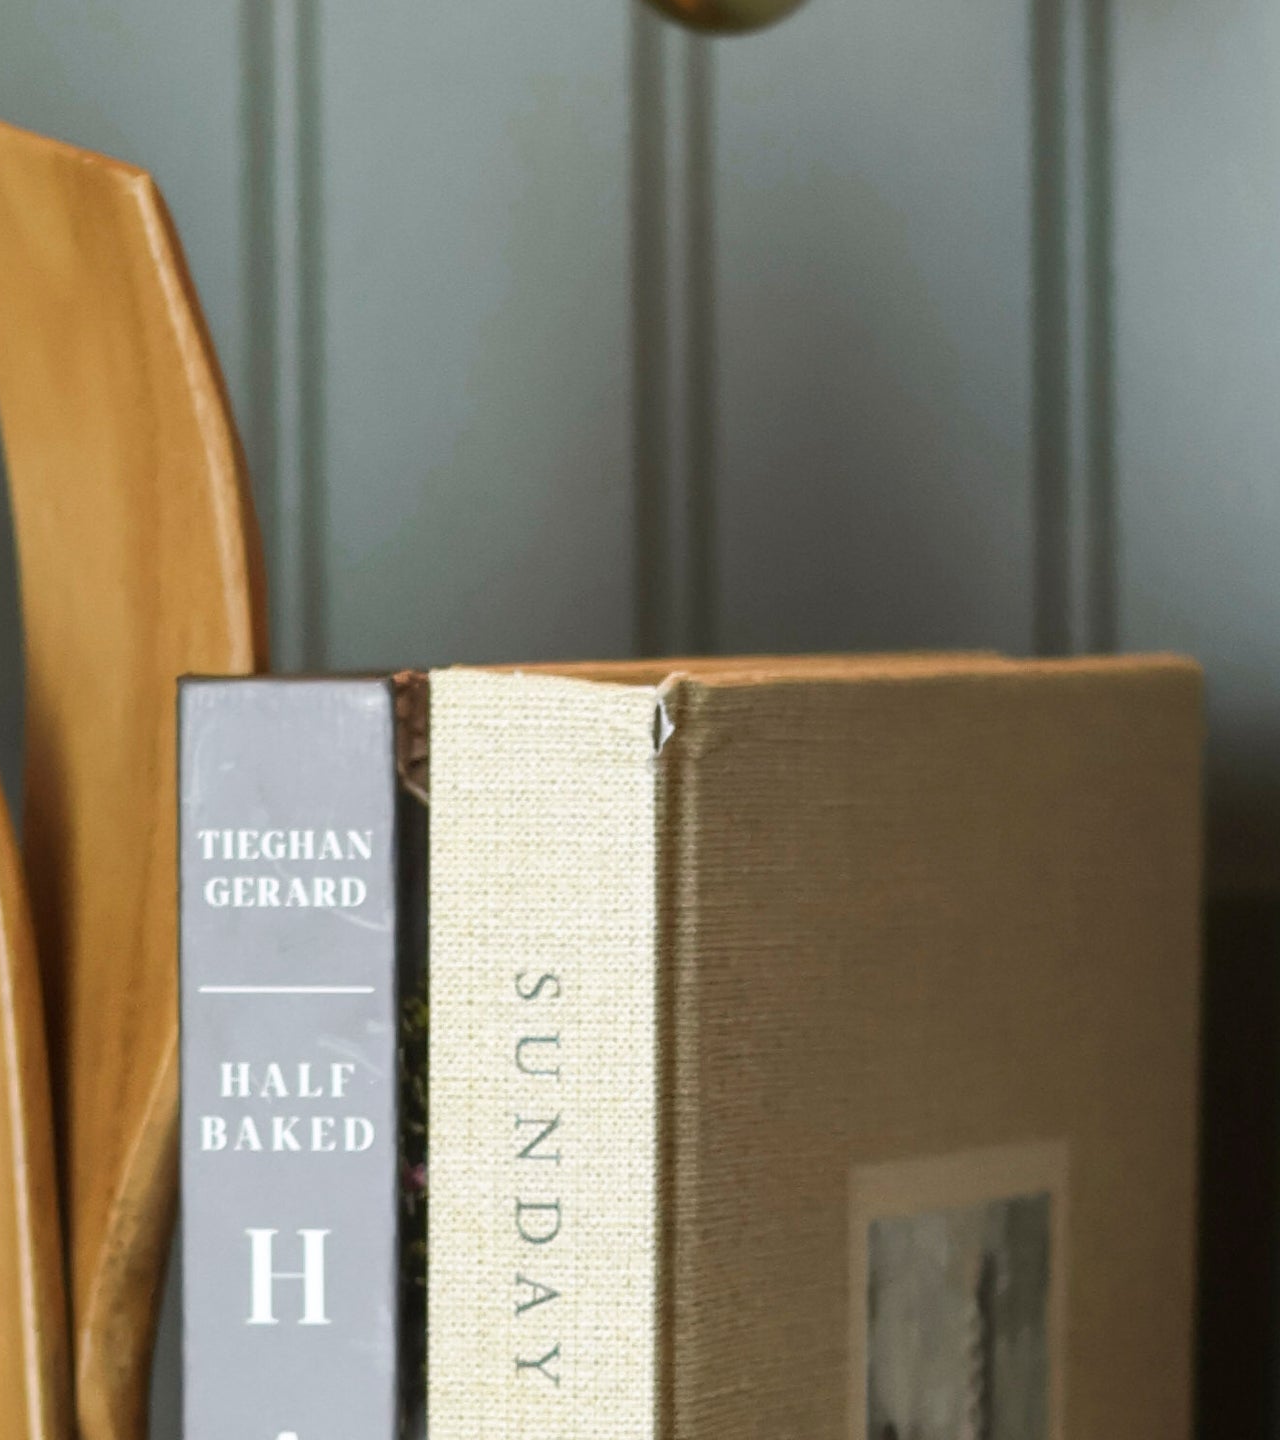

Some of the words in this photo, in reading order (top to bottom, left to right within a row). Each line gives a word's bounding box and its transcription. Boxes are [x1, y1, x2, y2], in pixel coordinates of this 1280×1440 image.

[197, 829, 374, 861] TIEGHAN
[203, 876, 368, 908] GERARD
[220, 1062, 355, 1099] HALF
[200, 1116, 376, 1152] BAKED
[515, 970, 562, 1387] SUNDAY
